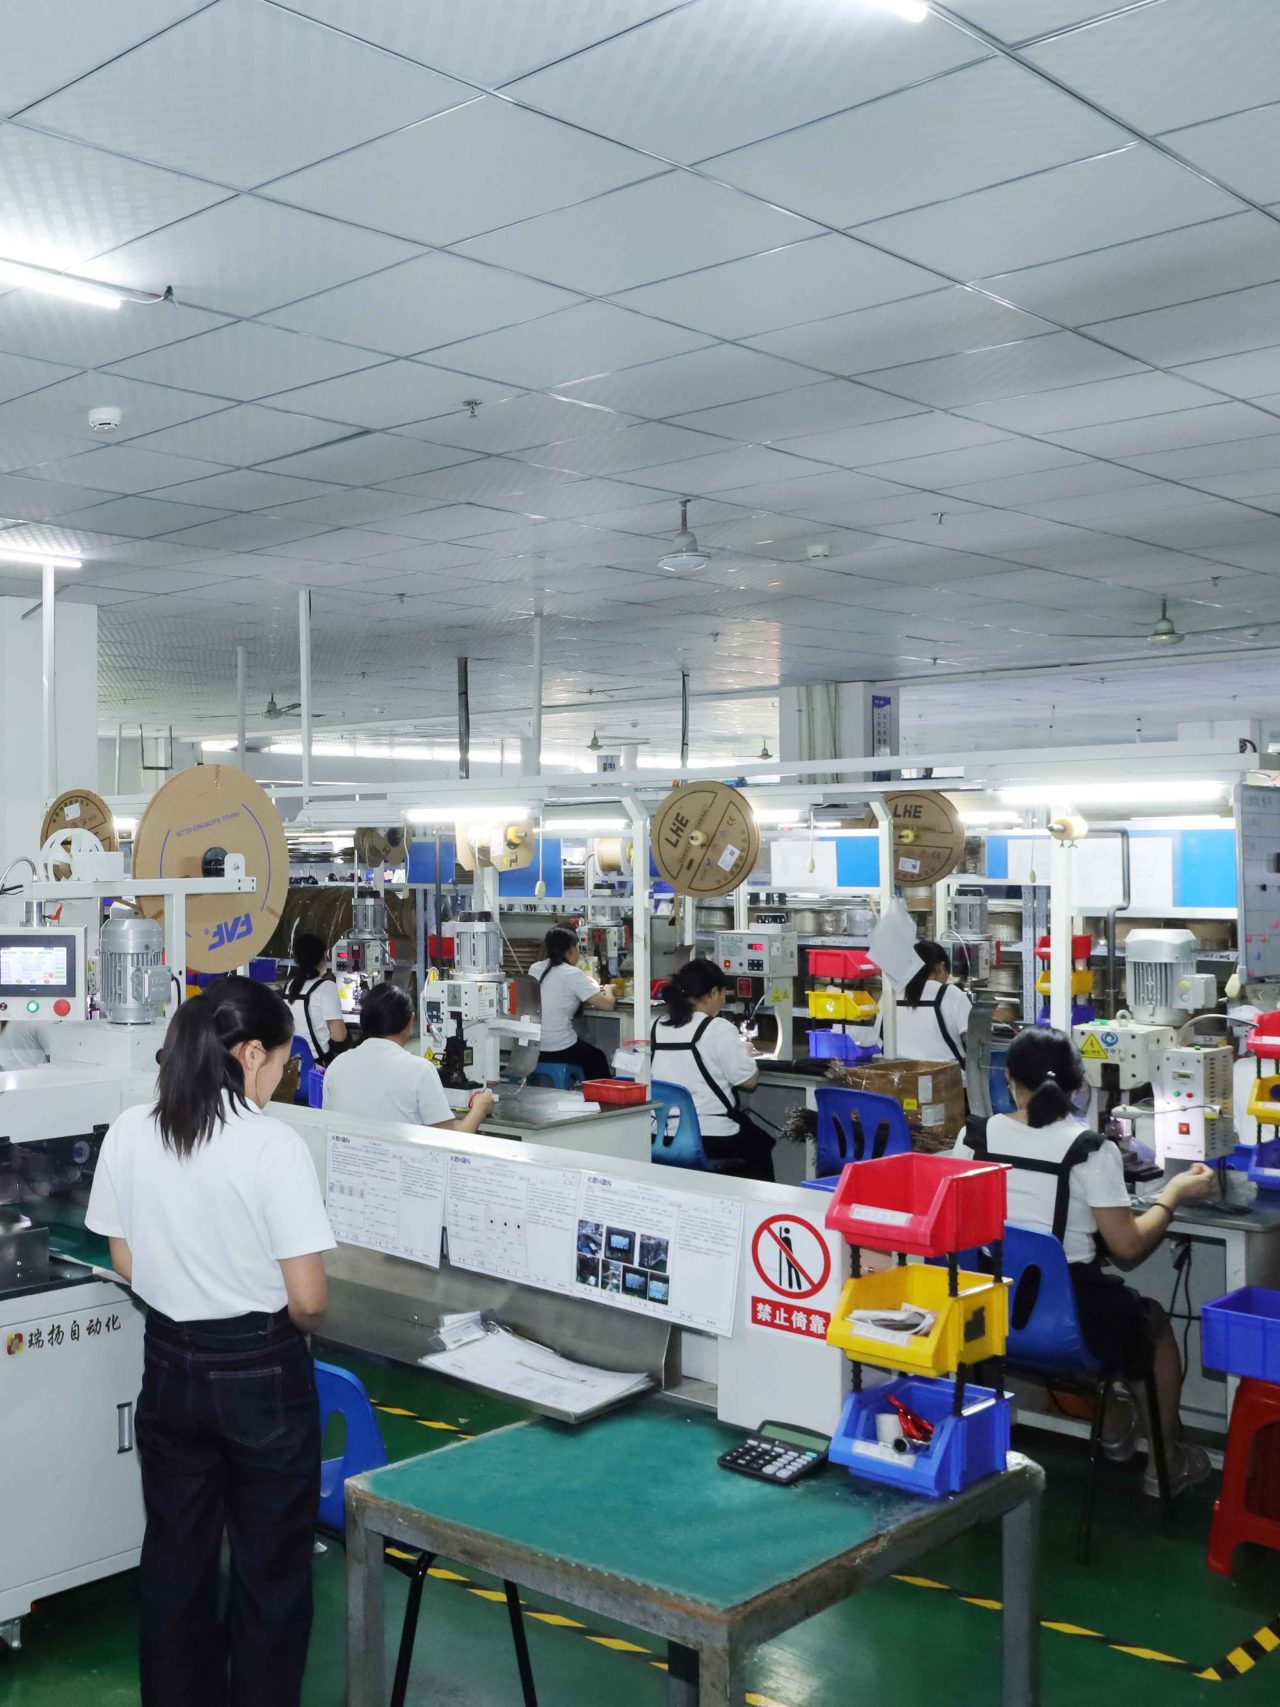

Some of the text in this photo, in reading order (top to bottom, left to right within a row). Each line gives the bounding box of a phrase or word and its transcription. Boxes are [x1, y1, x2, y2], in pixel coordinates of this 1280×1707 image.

[893, 804, 923, 819] LHE
[665, 812, 689, 848] LHE
[208, 912, 253, 951] FAF
[28, 1313, 121, 1349] 瑞扬自动化
[756, 1302, 826, 1335] 禁止倚靠
